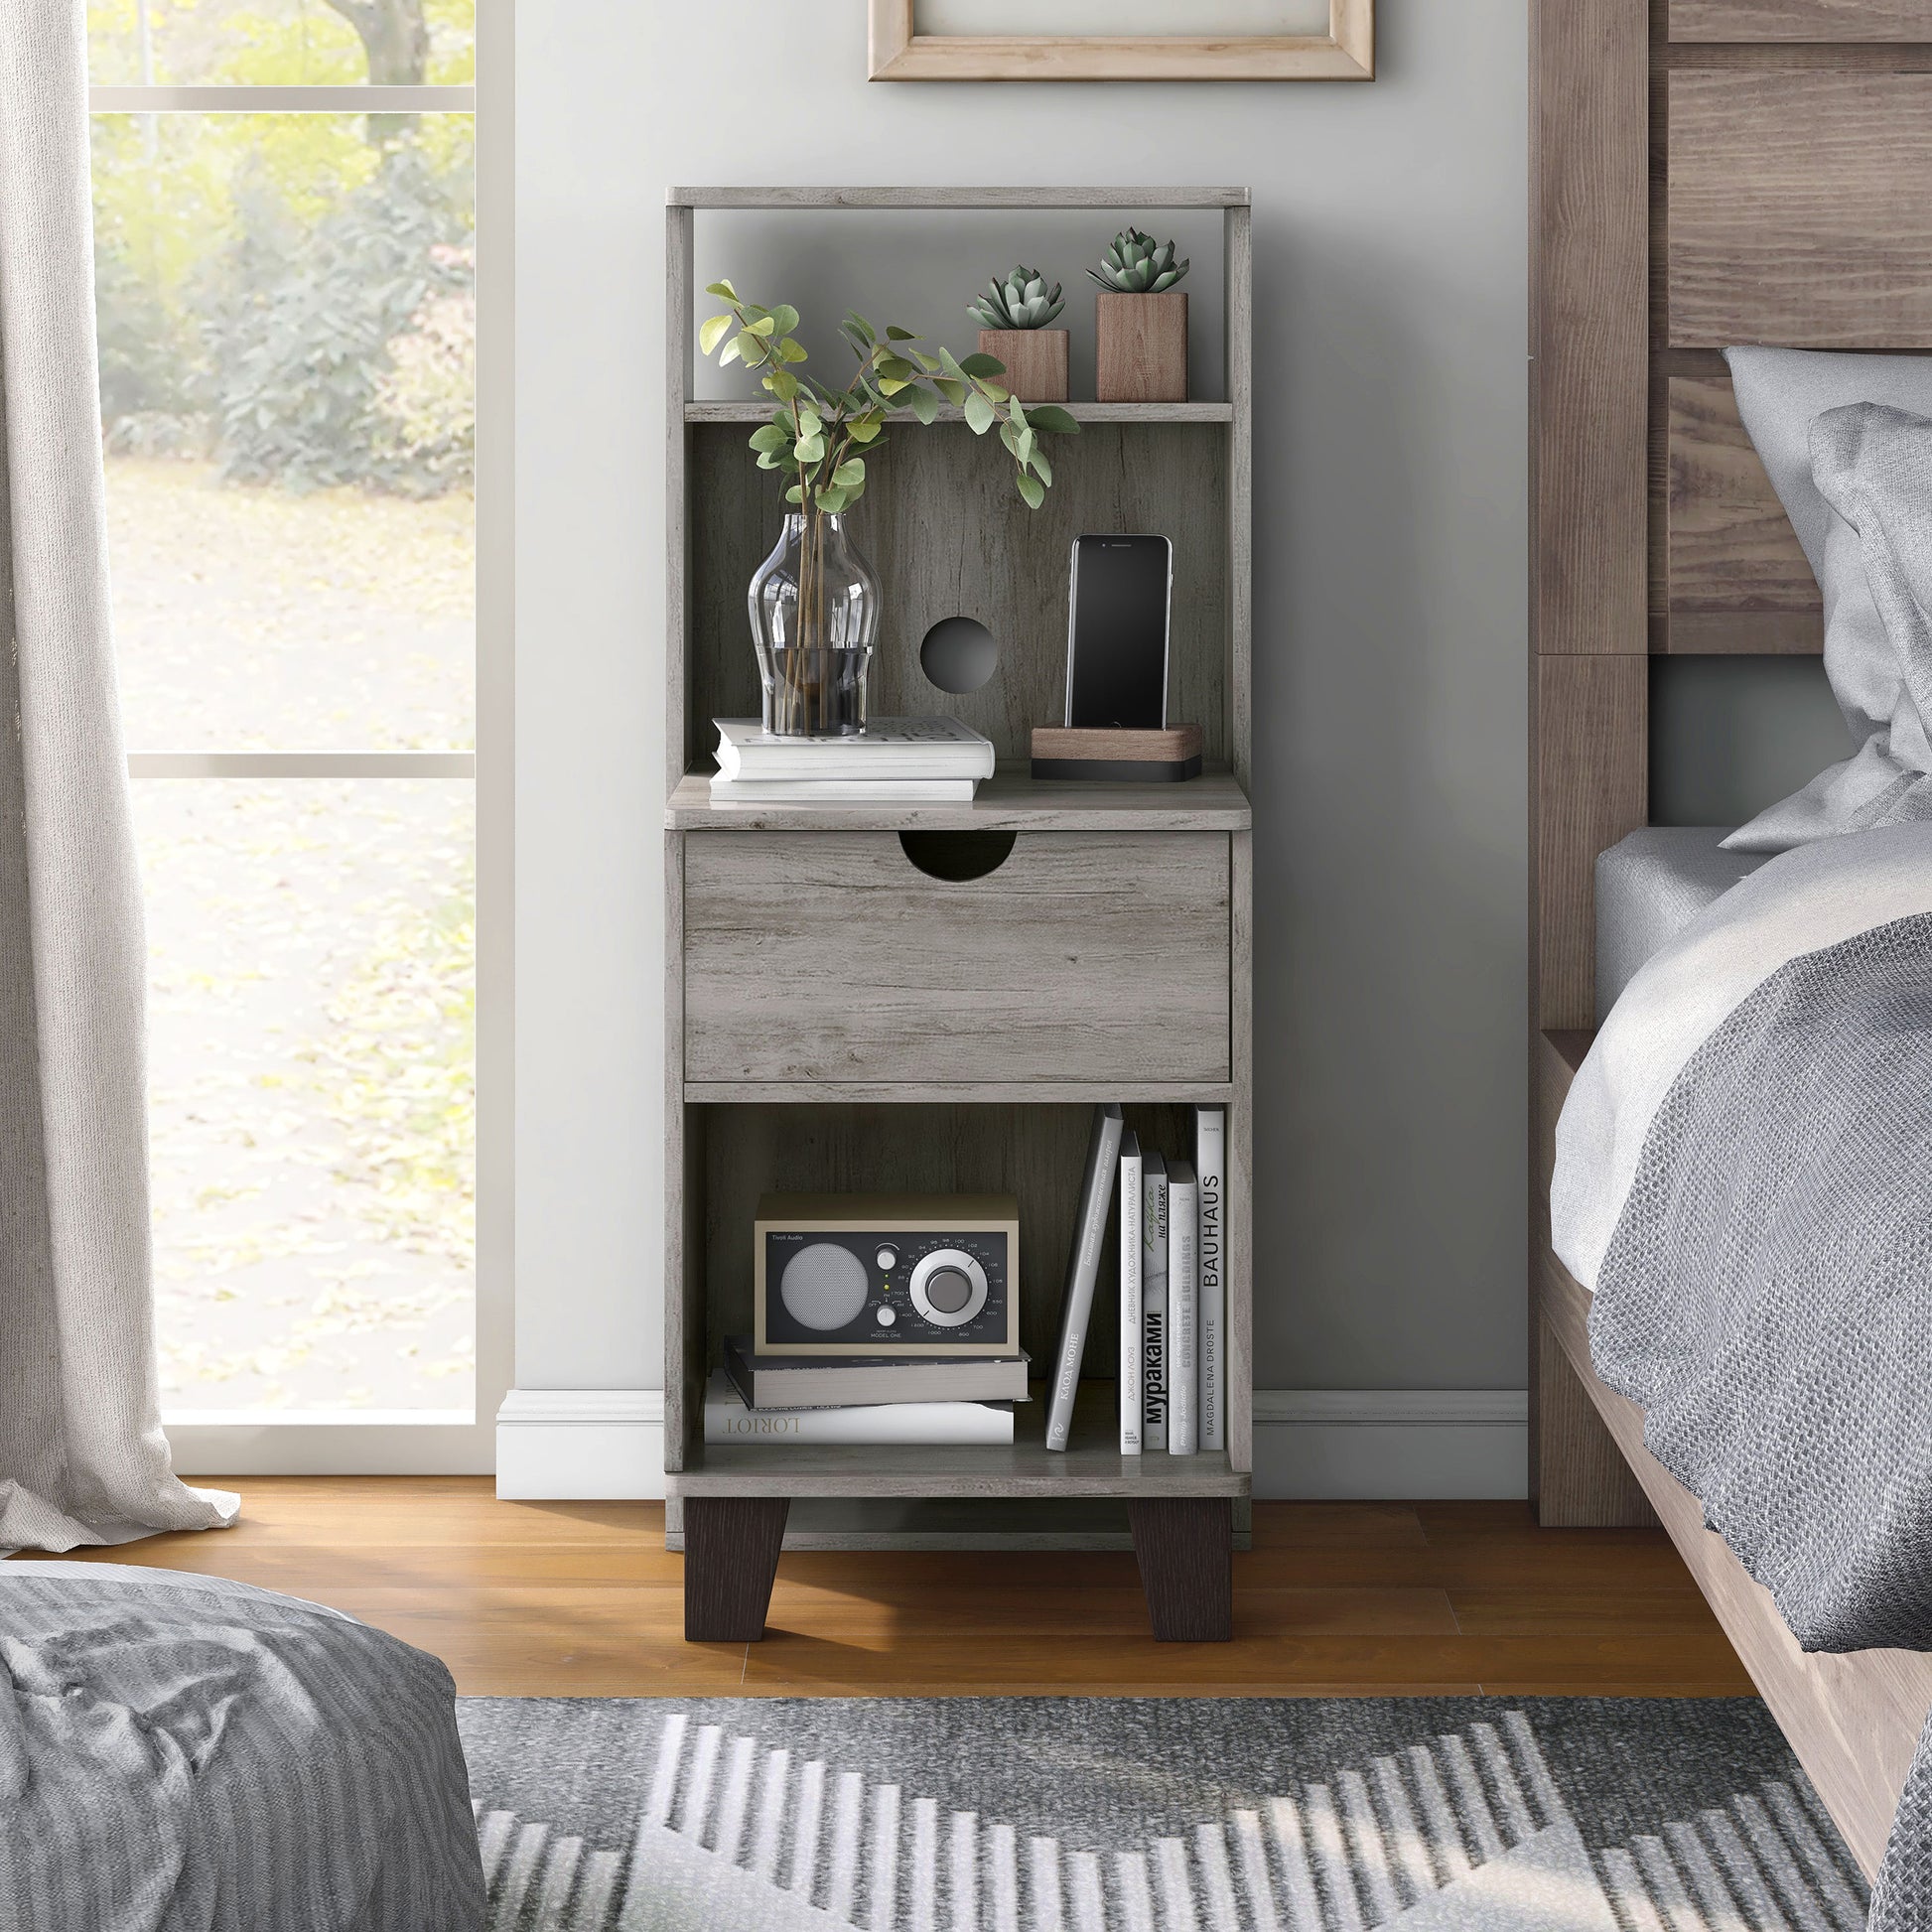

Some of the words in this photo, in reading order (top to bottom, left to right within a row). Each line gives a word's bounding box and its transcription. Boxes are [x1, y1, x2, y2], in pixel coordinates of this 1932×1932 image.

[1159, 1184, 1168, 1219] пляже
[1144, 1186, 1160, 1252] Кафка
[1159, 1221, 1166, 1239] на
[1203, 1174, 1219, 1287] BAUHAUS
[1181, 1235, 1191, 1302] BUILDINGS
[1066, 1333, 1079, 1367] МОНЕ
[1181, 1308, 1191, 1368] CONCRETE
[1127, 1346, 1136, 1371] ЛОУЗ
[1146, 1312, 1168, 1425] мураками
[1059, 1368, 1074, 1401] КЛОД
[1127, 1372, 1136, 1402] ДЖОН
[724, 1417, 801, 1435] LORIOT
